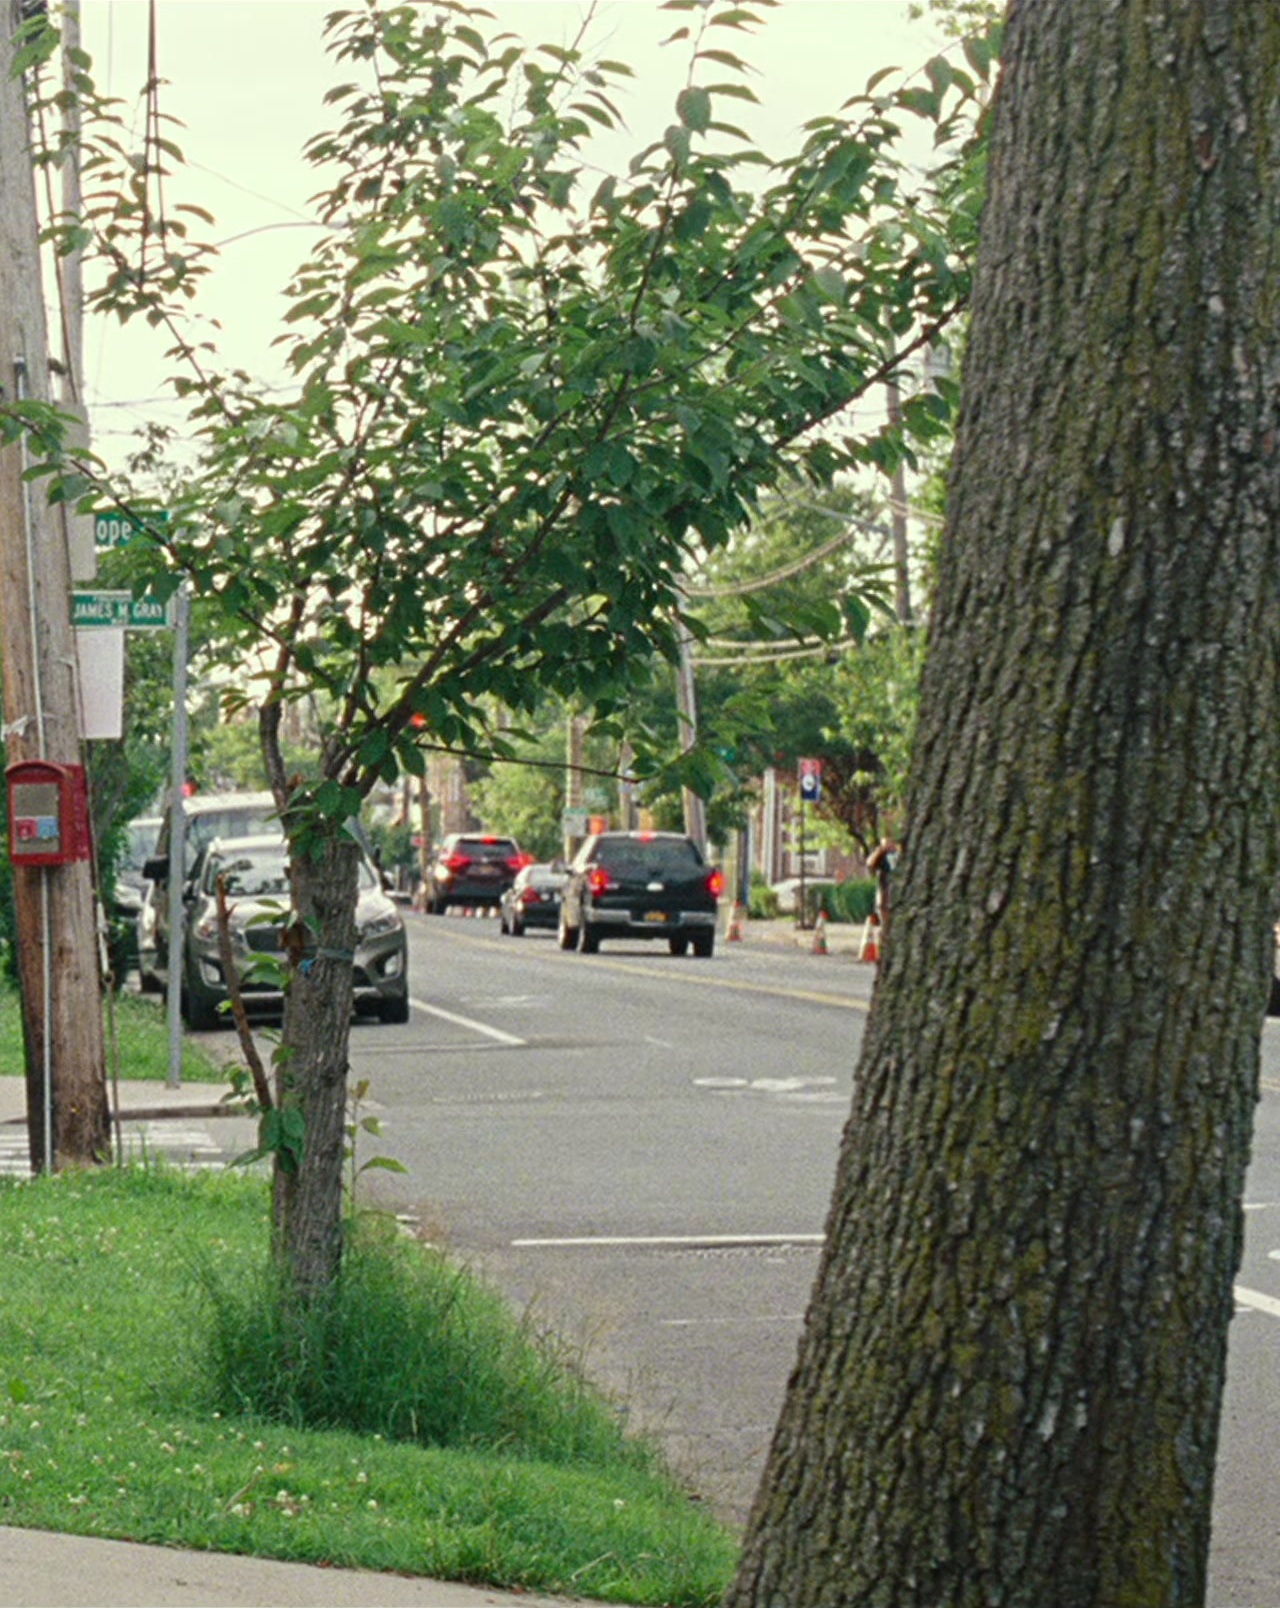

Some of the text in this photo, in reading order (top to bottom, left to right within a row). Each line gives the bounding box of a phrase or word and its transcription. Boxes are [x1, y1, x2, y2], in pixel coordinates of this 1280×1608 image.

[96, 520, 131, 545] ope
[74, 602, 113, 619] JAMES
[132, 602, 162, 618] GRAY
